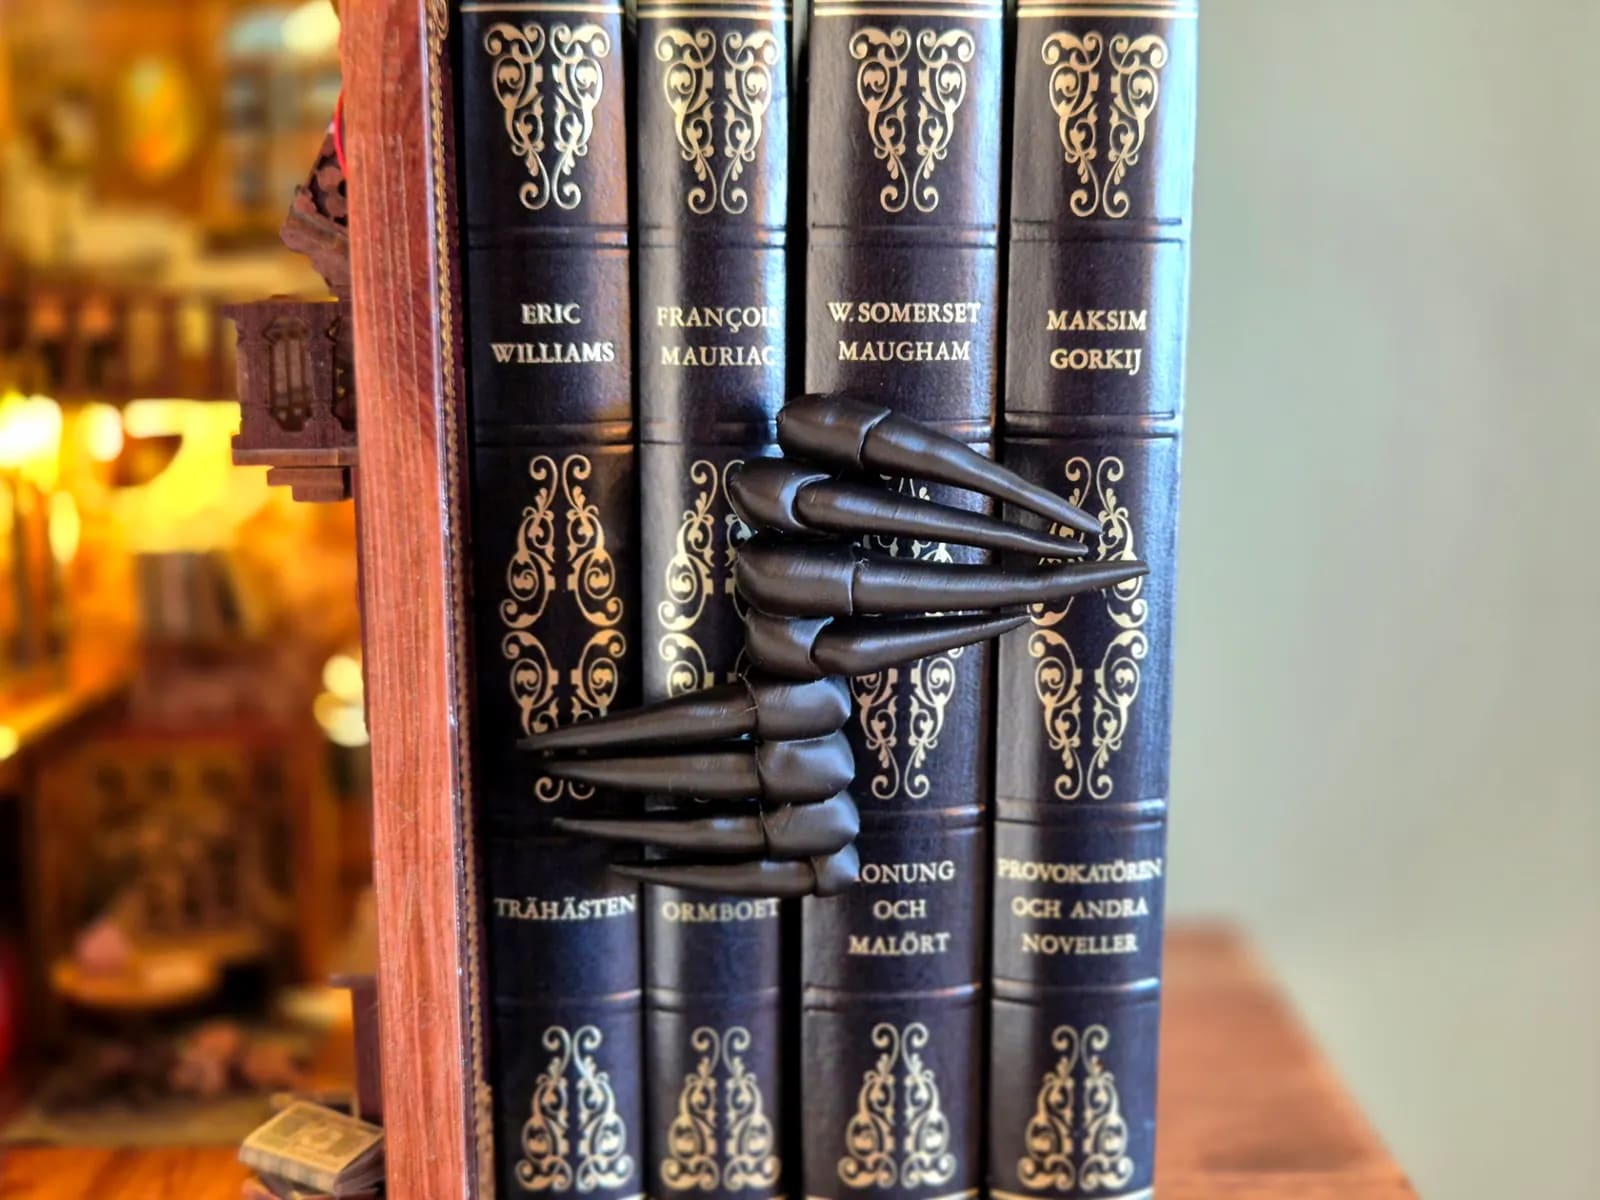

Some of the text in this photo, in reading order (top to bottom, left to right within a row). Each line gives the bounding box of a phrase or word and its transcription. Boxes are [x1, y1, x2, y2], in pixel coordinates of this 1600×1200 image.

[522, 303, 581, 325] ERIC
[827, 302, 982, 323] W. SOMERSET
[1046, 309, 1147, 332] MAKSIM
[491, 342, 615, 364] WILLIAMS
[660, 345, 775, 366] MAURIAC
[838, 341, 971, 362] MAUGHAM
[1050, 348, 1142, 376] GORKIJ
[853, 860, 956, 883] ONUNG
[997, 857, 1163, 884] PROVOKATÖREN
[494, 894, 637, 920] TRÄHÄSTEN
[661, 897, 781, 922] ORMBOET
[873, 899, 926, 920] OCH
[1011, 896, 1149, 919] OCH ANDRA
[848, 931, 950, 956] MALÖRT
[1021, 933, 1138, 955] NOVELLER
